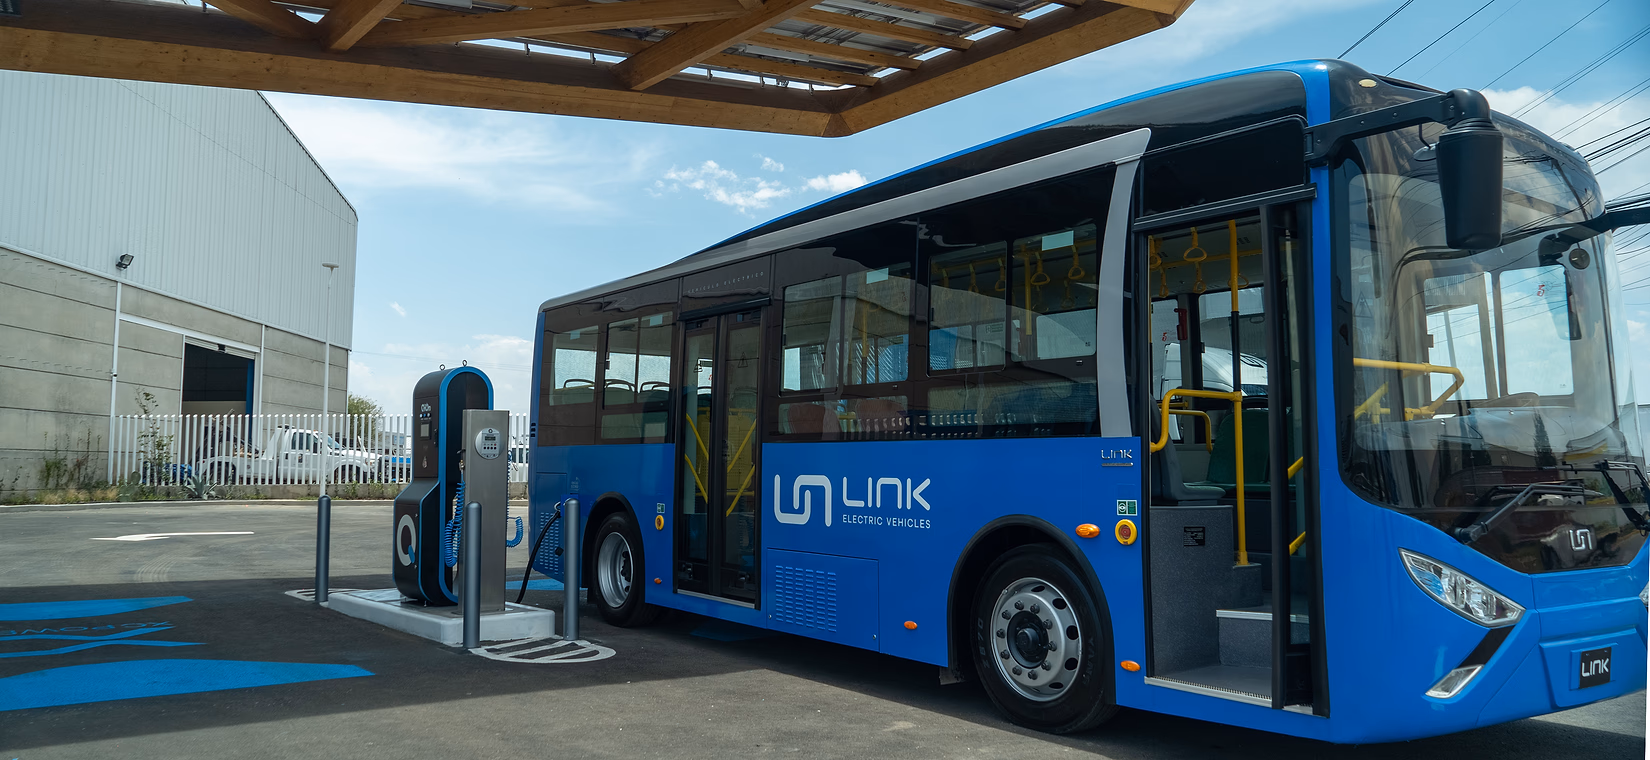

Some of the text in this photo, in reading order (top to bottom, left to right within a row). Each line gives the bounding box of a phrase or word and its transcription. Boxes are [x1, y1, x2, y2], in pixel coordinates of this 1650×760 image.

[1101, 449, 1132, 459] LINK
[842, 476, 931, 511] LINK
[842, 514, 931, 529] ELECTRIC VEHICLES
[1581, 657, 1610, 678] LINK
